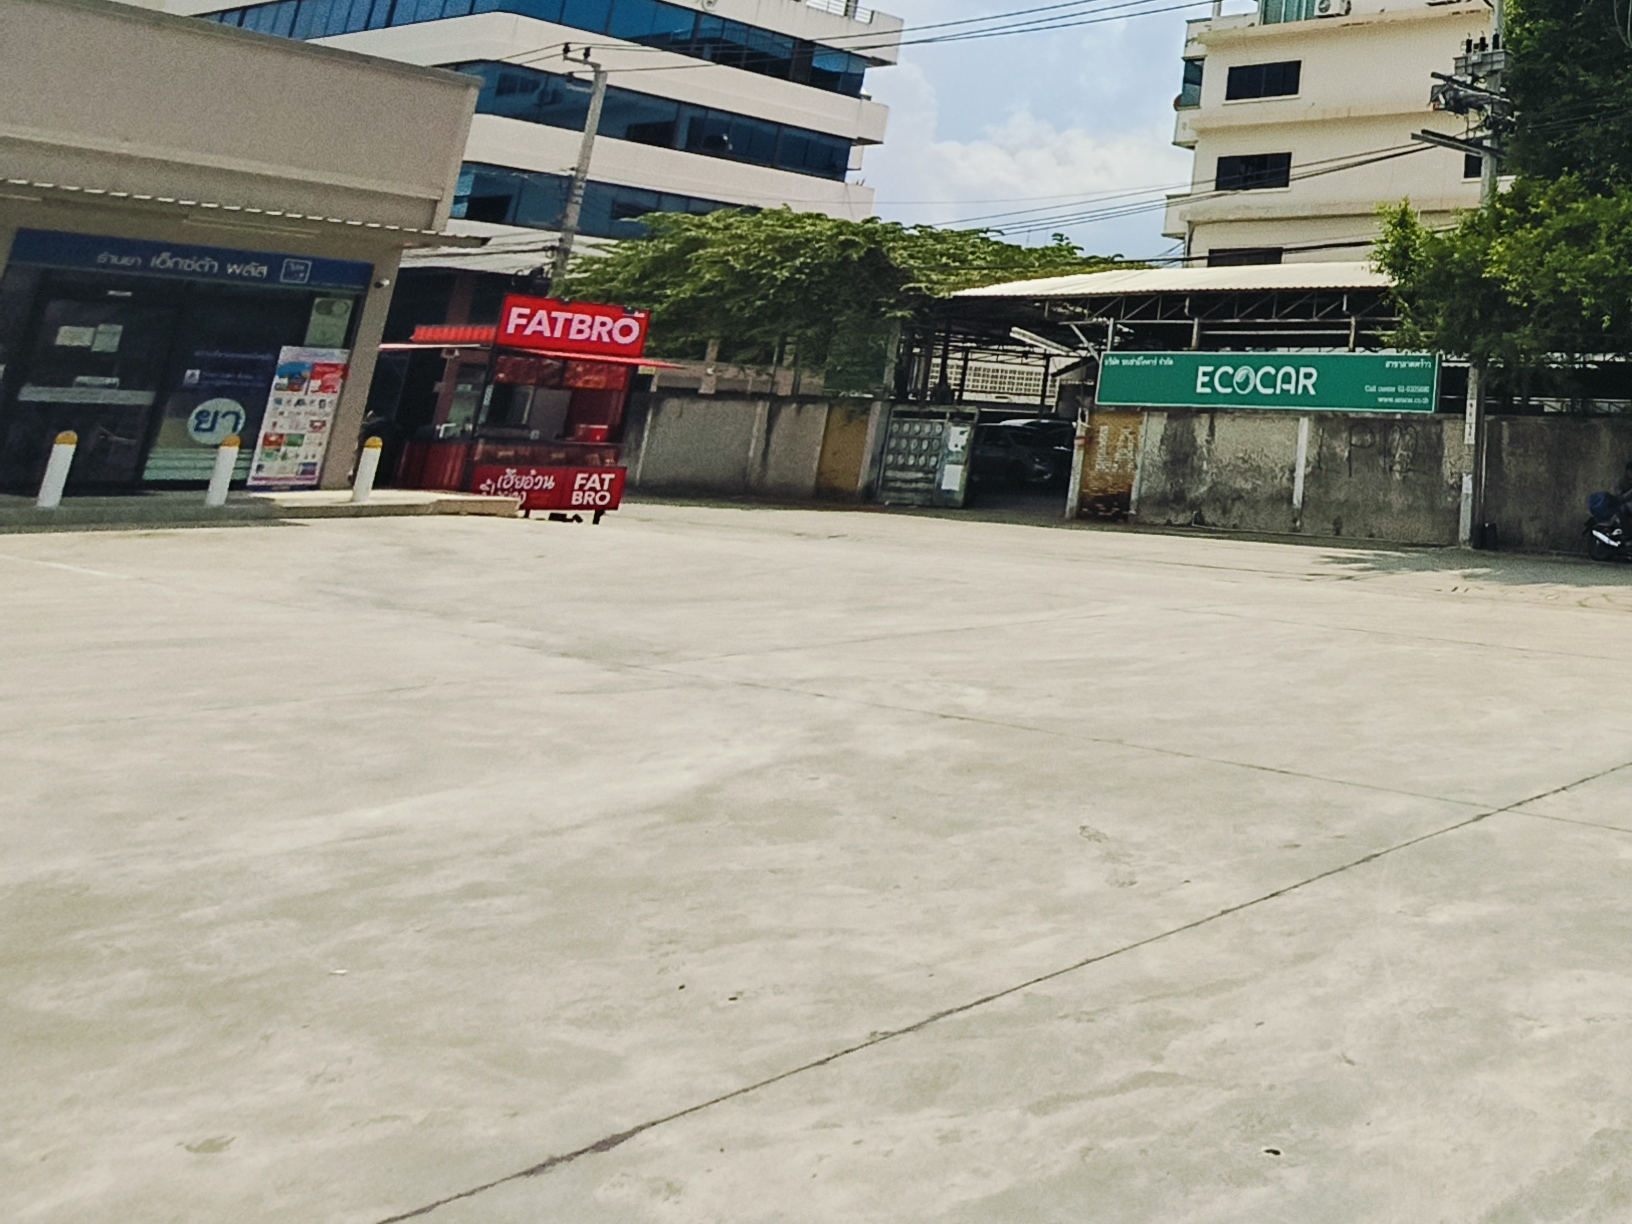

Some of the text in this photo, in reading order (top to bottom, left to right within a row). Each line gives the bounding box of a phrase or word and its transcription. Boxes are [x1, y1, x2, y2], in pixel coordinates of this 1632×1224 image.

[506, 306, 640, 345] FATBRO
[1196, 365, 1318, 396] ECOCAR
[193, 409, 241, 433] ยา
[573, 473, 616, 491] FAT
[570, 490, 611, 506] BRO
